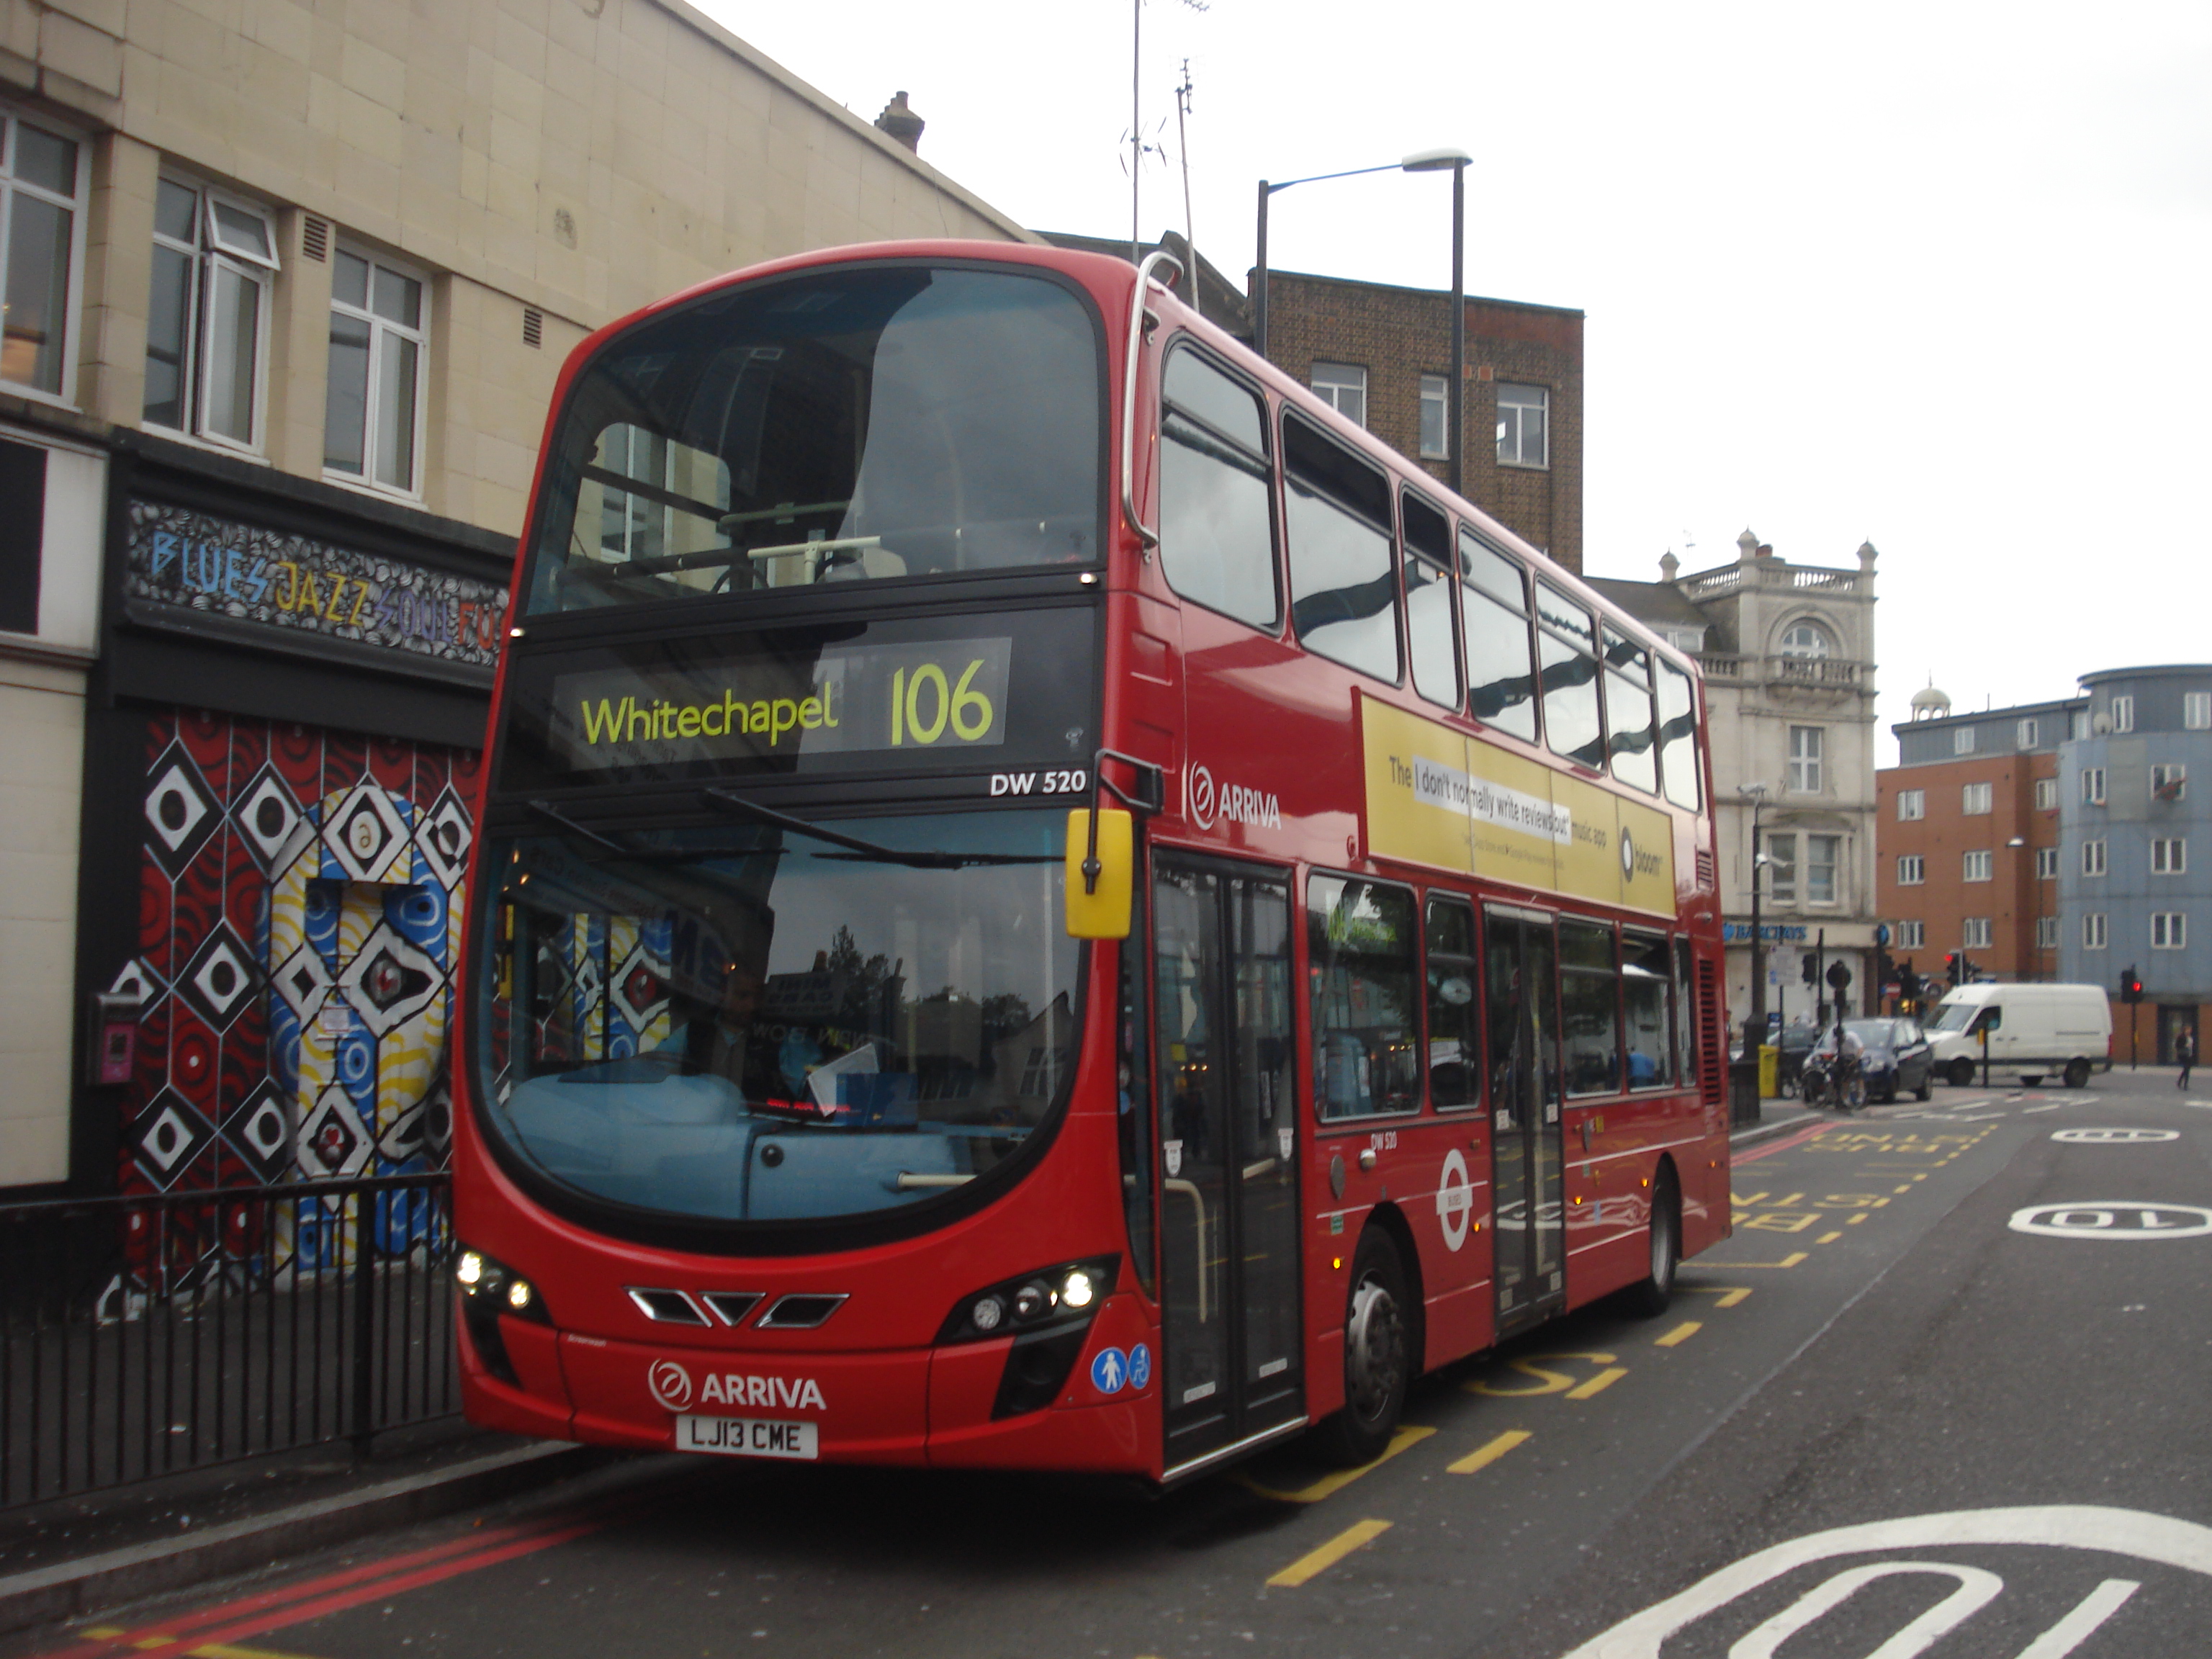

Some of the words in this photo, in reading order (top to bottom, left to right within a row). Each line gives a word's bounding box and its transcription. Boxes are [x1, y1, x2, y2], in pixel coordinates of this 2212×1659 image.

[151, 530, 269, 603] BLUES
[275, 561, 369, 626] JAZZ
[373, 588, 452, 643] SOUL
[581, 680, 839, 746] Whitechapel
[890, 658, 993, 746] 106
[990, 772, 1036, 797] DW
[1043, 770, 1087, 793] 520
[1389, 755, 1411, 788] The
[1422, 765, 1450, 801] don't
[1453, 782, 1494, 819] normally
[1497, 793, 1519, 822] write
[1521, 803, 1553, 832] reviews
[1218, 782, 1282, 831] ARRIVA
[1370, 1133, 1384, 1151] DW
[701, 1372, 827, 1411] ARRIVA
[691, 1417, 745, 1449] LJ13
[752, 1423, 801, 1452] CME
